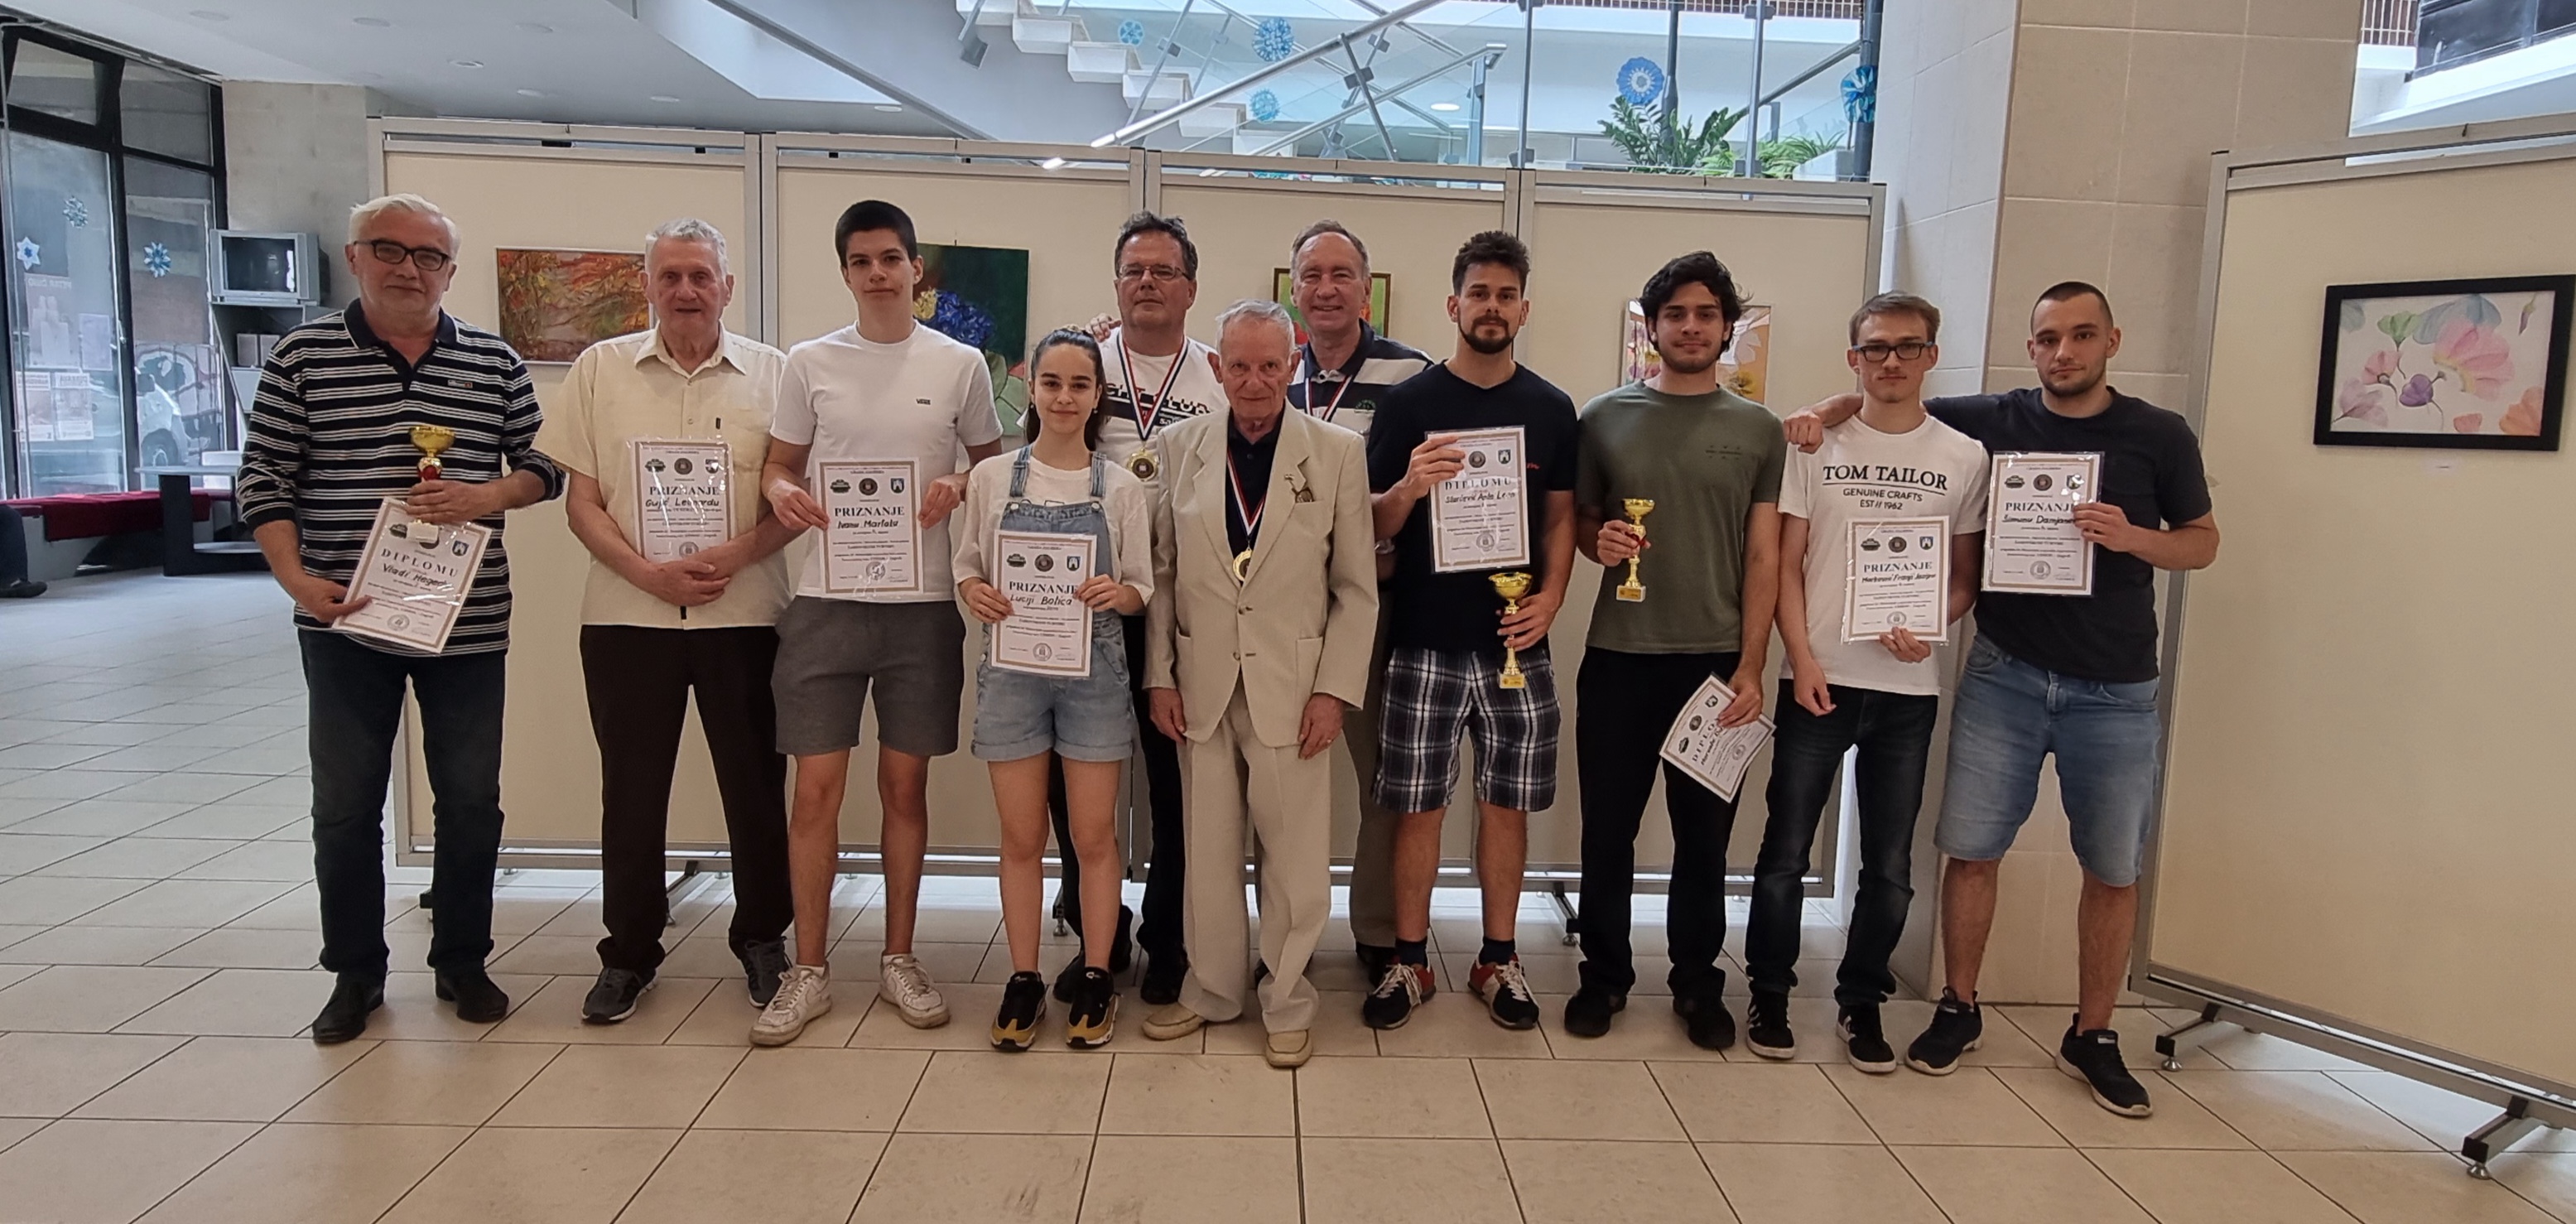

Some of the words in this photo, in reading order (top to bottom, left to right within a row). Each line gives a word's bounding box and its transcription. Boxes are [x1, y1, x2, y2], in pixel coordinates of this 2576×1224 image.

[1822, 465, 1869, 480] TOM
[1875, 465, 1948, 490] TAILOR
[1842, 488, 1885, 498] GENUINE
[1887, 490, 1924, 502] CRAFTS
[835, 506, 905, 517] PRIZNANJE
[1884, 501, 1903, 510] 1962
[381, 548, 459, 577] DIPLOMU
[1864, 561, 1933, 572] PRIZNANJE
